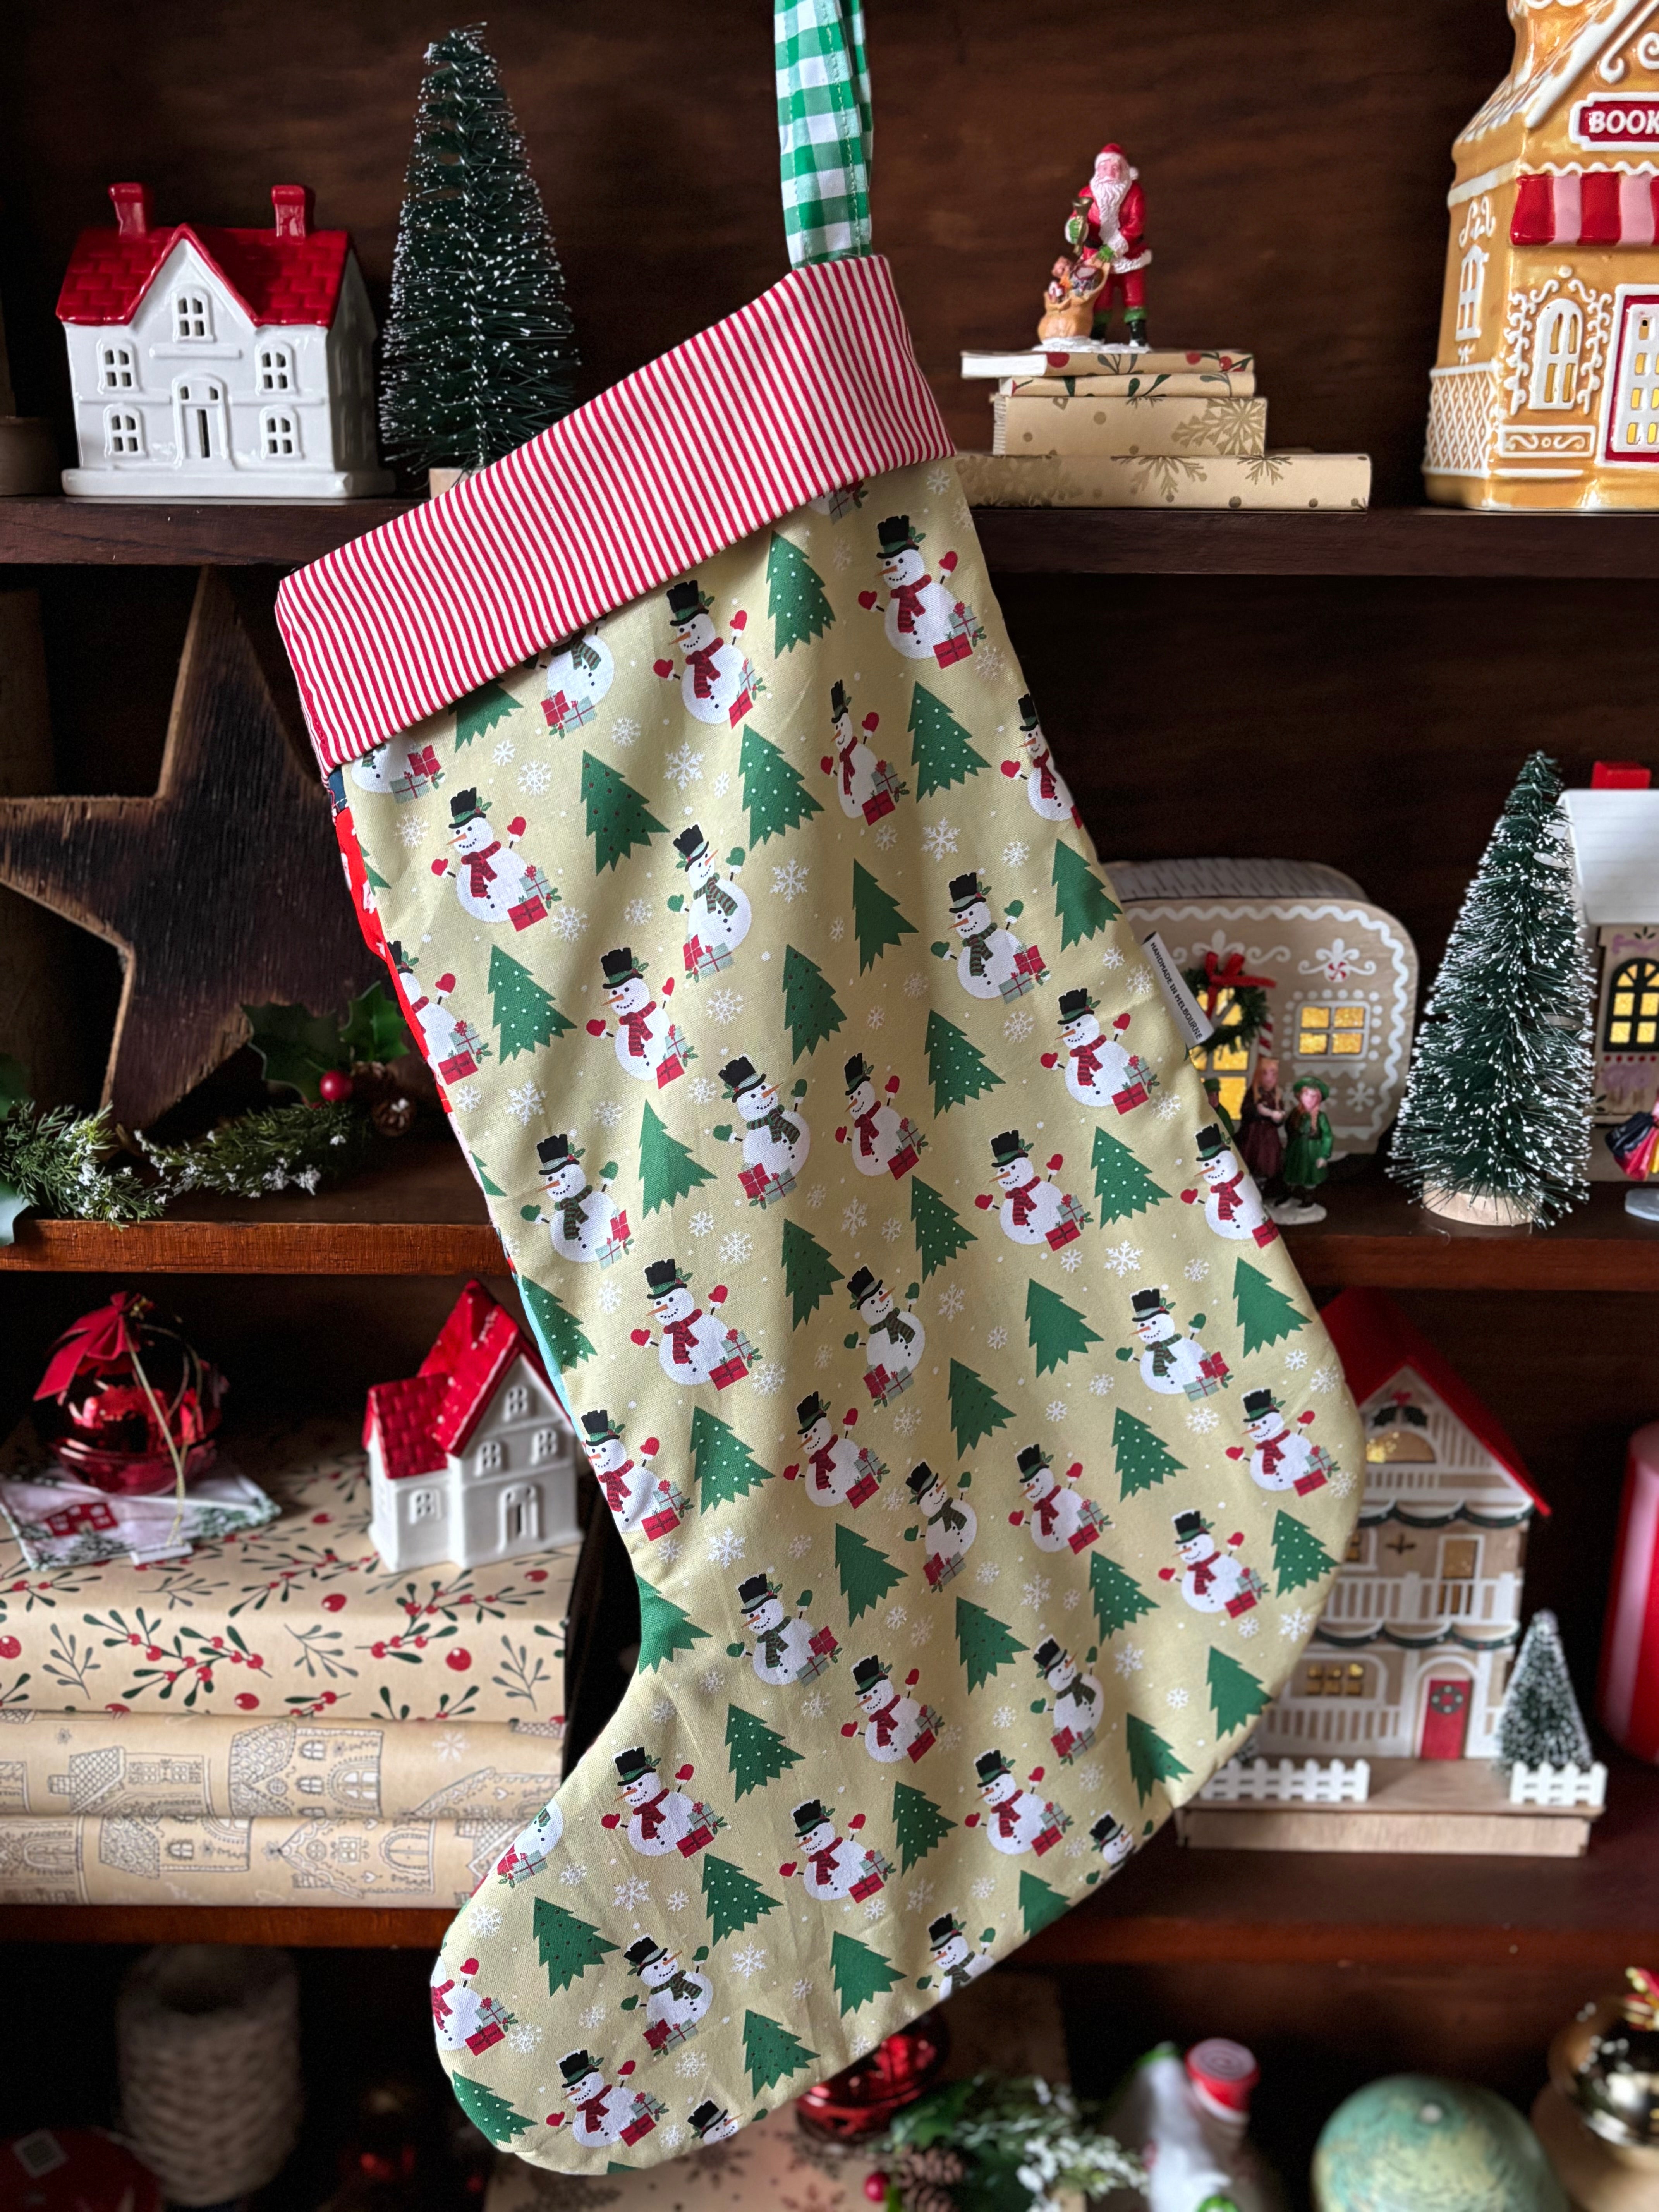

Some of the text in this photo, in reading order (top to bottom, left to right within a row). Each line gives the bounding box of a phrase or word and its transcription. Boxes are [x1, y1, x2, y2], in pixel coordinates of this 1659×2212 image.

[1151, 942, 1203, 1040] HANDMADE IN MELBOURNE
